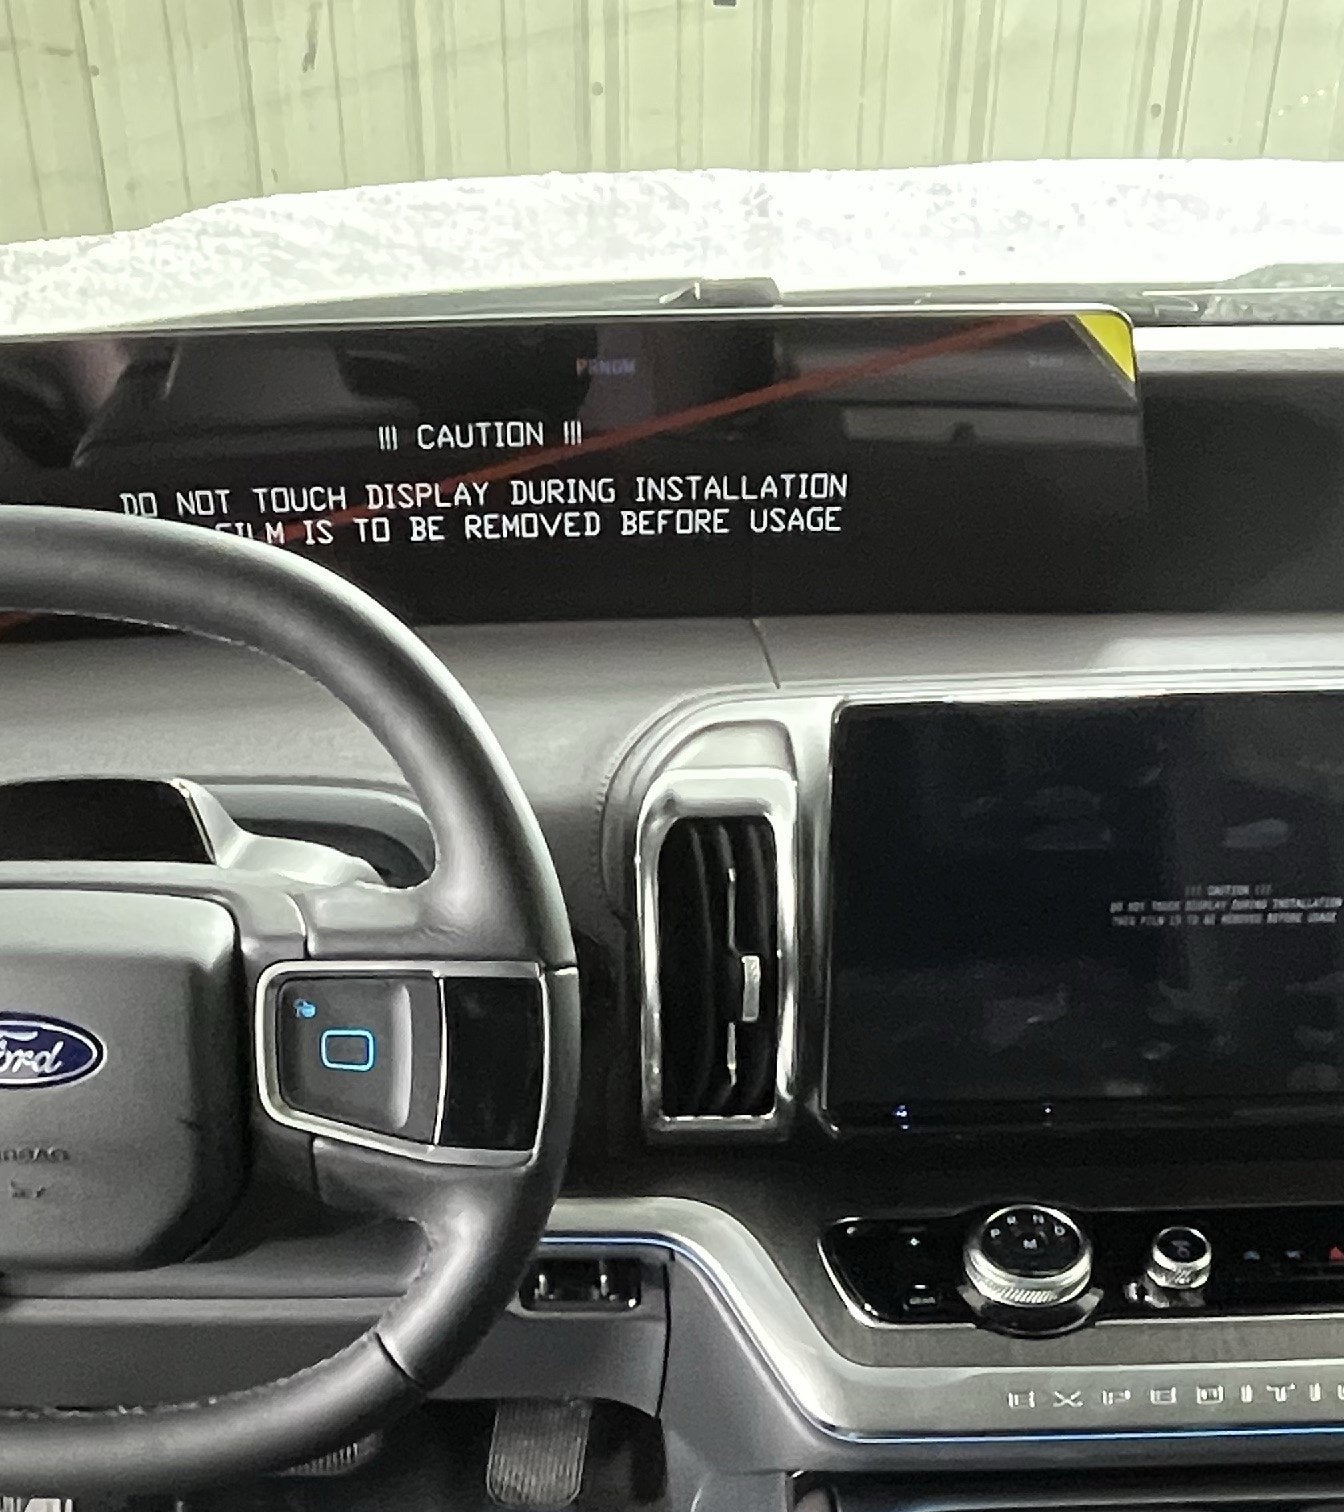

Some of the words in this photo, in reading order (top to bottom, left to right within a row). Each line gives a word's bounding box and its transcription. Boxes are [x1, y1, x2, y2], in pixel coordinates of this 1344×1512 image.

[417, 421, 544, 450] CAUTION
[119, 492, 158, 517] DO
[176, 489, 230, 516] NOT
[252, 486, 347, 514] TOUCH
[364, 481, 488, 510] DISPLAY
[510, 478, 616, 506] DURING
[635, 473, 848, 502] INSTALLATION
[303, 519, 334, 545] IS
[353, 517, 391, 543] TO
[409, 515, 446, 542] BE
[464, 511, 601, 540] REMOVED
[620, 508, 730, 536] BEFORE
[750, 506, 842, 534] USAGE
